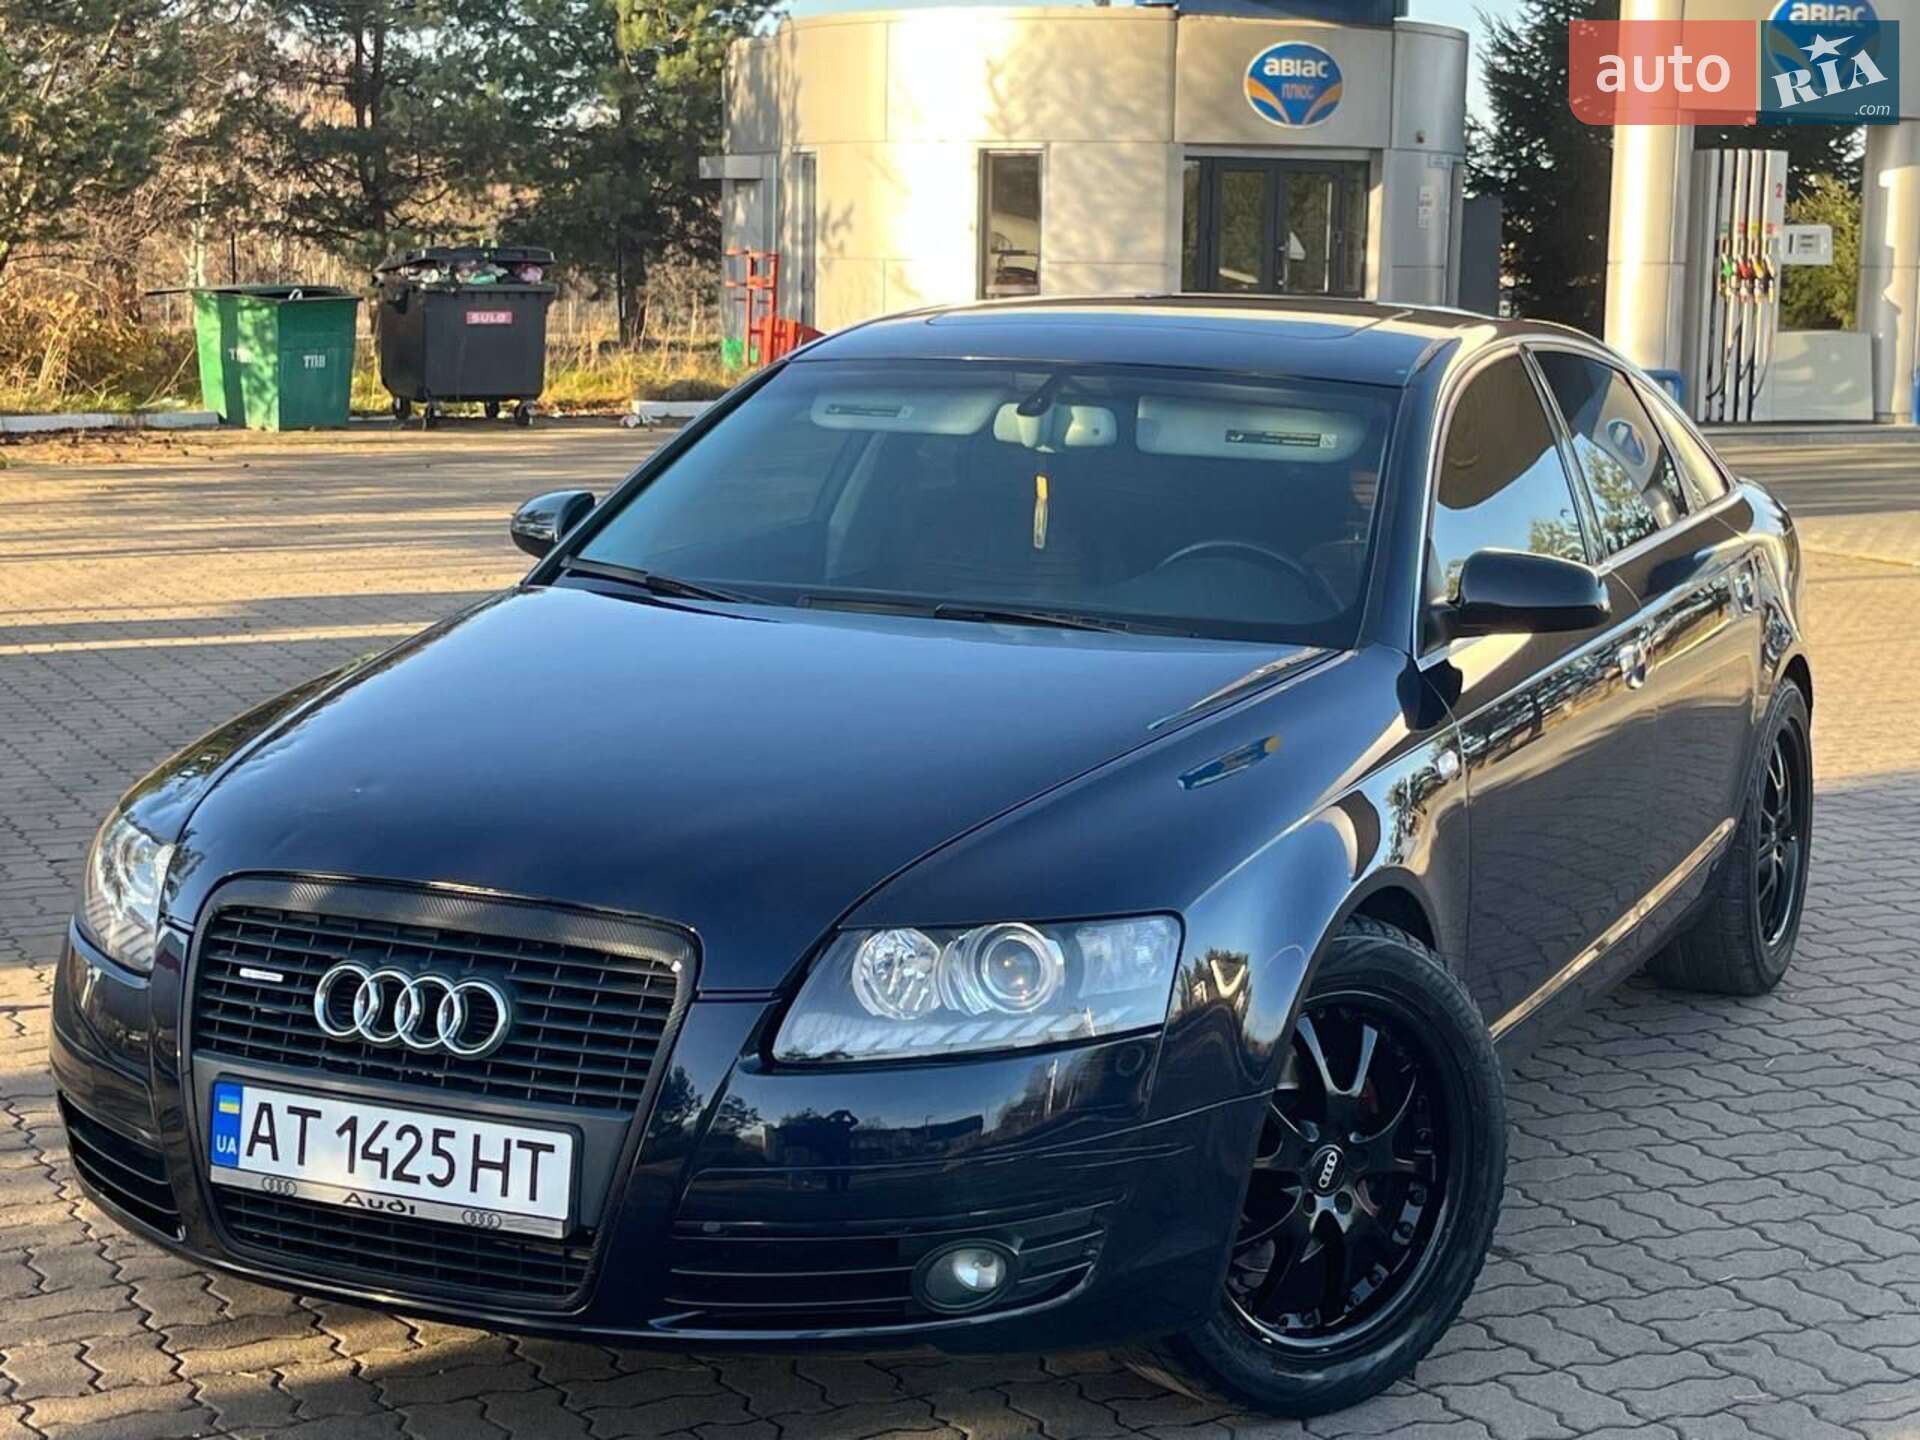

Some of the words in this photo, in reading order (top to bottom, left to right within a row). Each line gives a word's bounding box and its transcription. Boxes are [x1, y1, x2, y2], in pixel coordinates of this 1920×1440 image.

[1776, 183, 1783, 198] 2
[216, 1134, 237, 1155] UA
[246, 1102, 322, 1166] AT
[336, 1115, 456, 1188] 1425
[470, 1134, 555, 1202] HT
[343, 1192, 416, 1216] Audi
